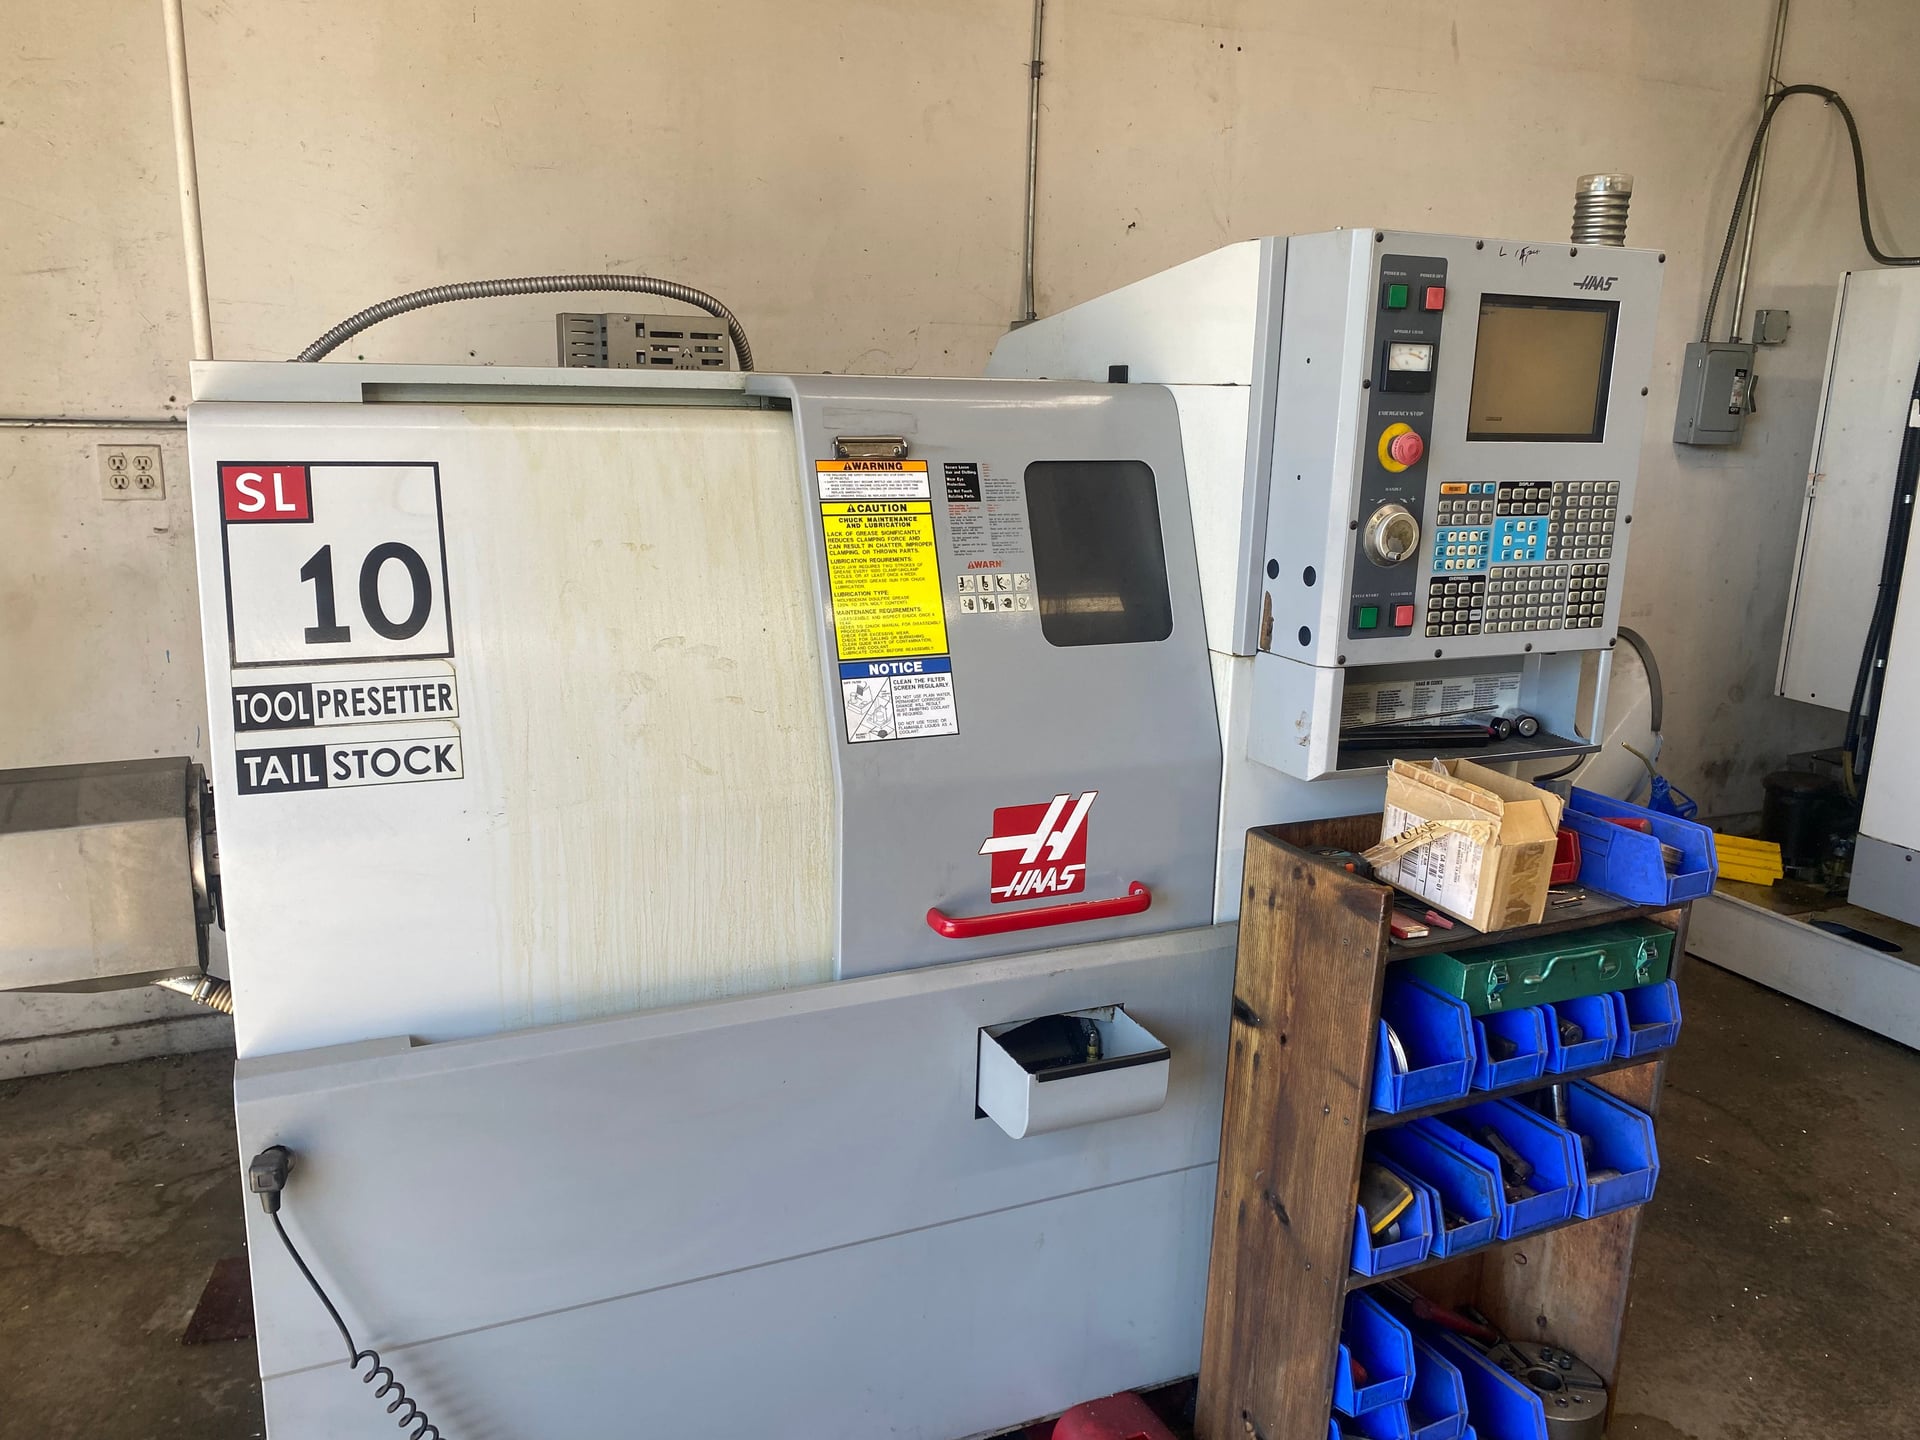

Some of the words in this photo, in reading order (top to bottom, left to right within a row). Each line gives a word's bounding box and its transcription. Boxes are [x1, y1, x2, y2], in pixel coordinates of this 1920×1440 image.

[1573, 275, 1618, 291] HAAS
[235, 472, 296, 512] SL
[857, 504, 907, 512] CAUTION
[300, 541, 432, 644] 10
[868, 662, 923, 675] NOTICE
[236, 691, 310, 724] TOOL
[318, 683, 453, 718] PRESETTER
[243, 753, 320, 788] TAIL
[332, 744, 456, 780] STOCK
[991, 863, 1086, 898] HAAS
